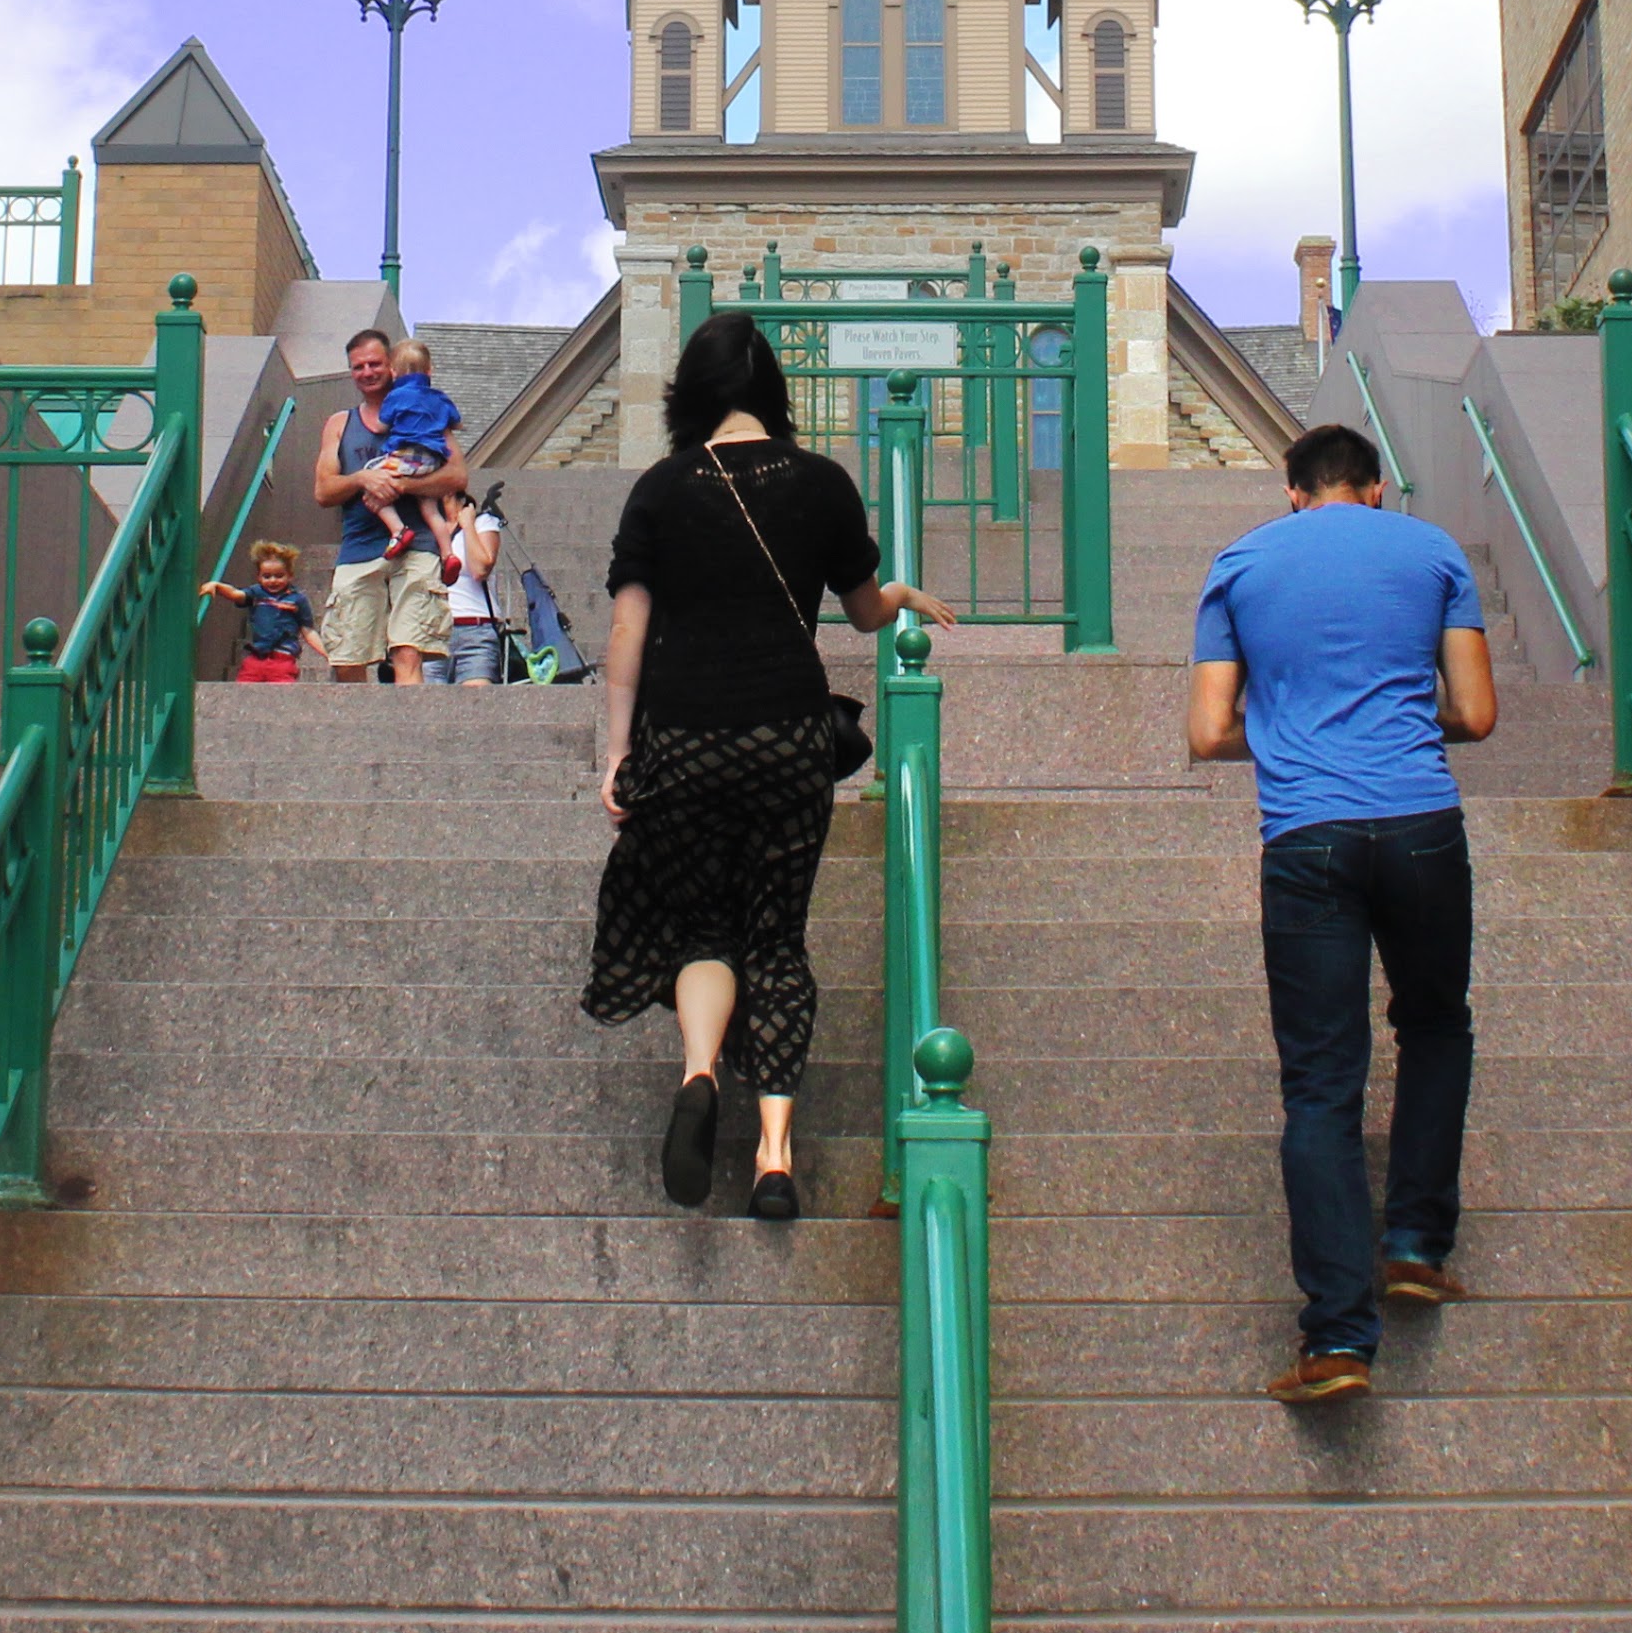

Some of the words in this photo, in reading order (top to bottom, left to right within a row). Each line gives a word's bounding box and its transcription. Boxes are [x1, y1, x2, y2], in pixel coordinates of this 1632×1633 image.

[844, 329, 871, 343] Please
[872, 329, 898, 343] Watch
[900, 329, 918, 343] Your
[862, 346, 892, 360] Uneven
